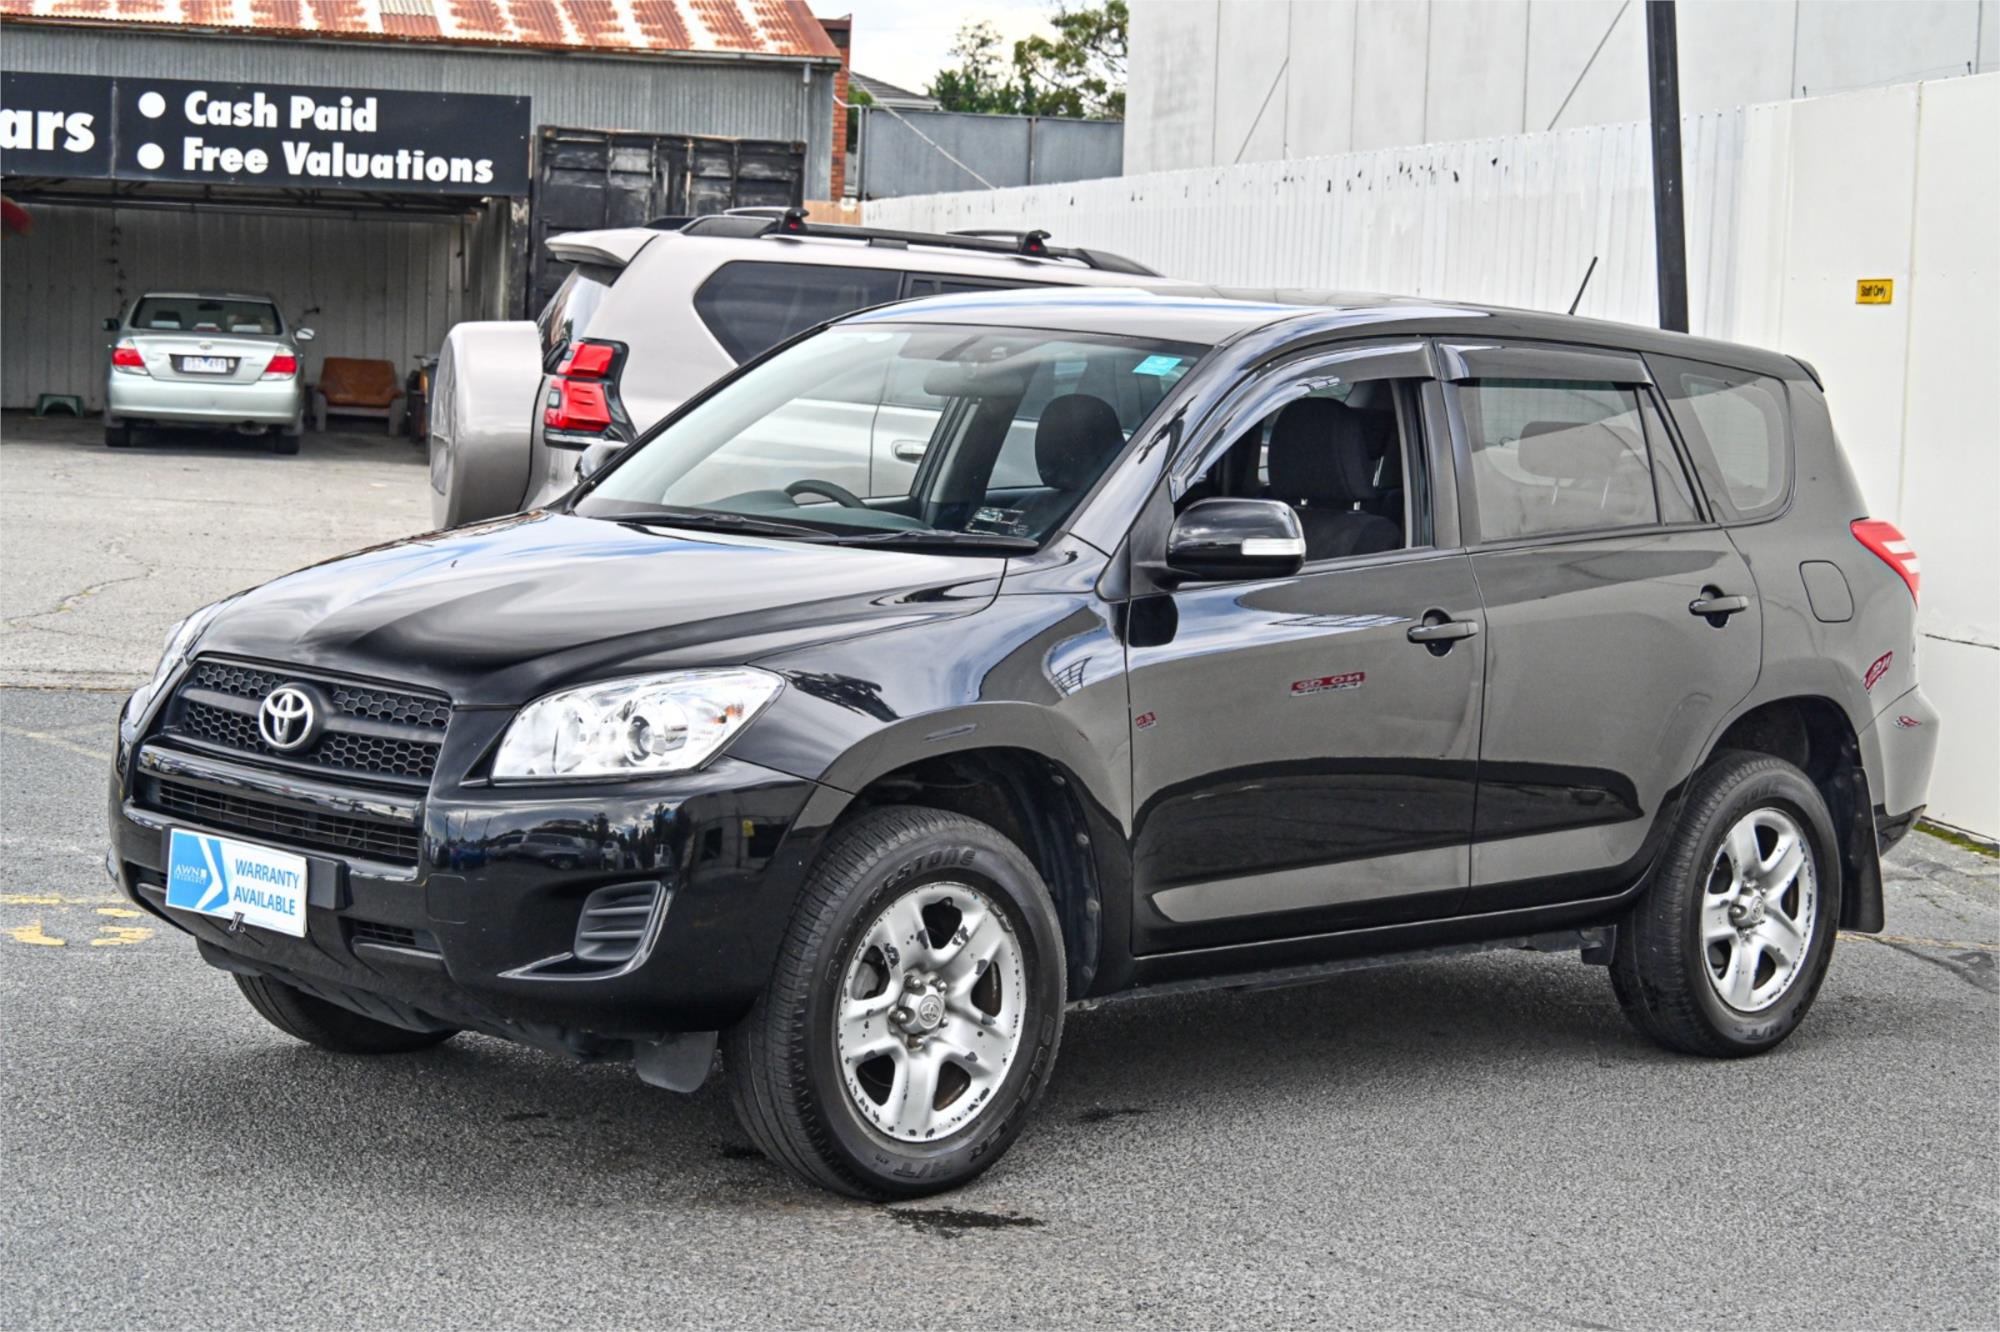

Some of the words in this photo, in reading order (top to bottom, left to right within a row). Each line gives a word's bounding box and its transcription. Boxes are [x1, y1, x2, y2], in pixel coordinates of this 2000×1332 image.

[184, 91, 277, 129] Cash
[290, 95, 377, 132] Paid
[183, 137, 268, 173] Free
[282, 140, 493, 184] Valuations
[175, 864, 200, 877] AWN
[235, 858, 300, 889] WARRANTY
[233, 886, 296, 916] AVAILABLE
